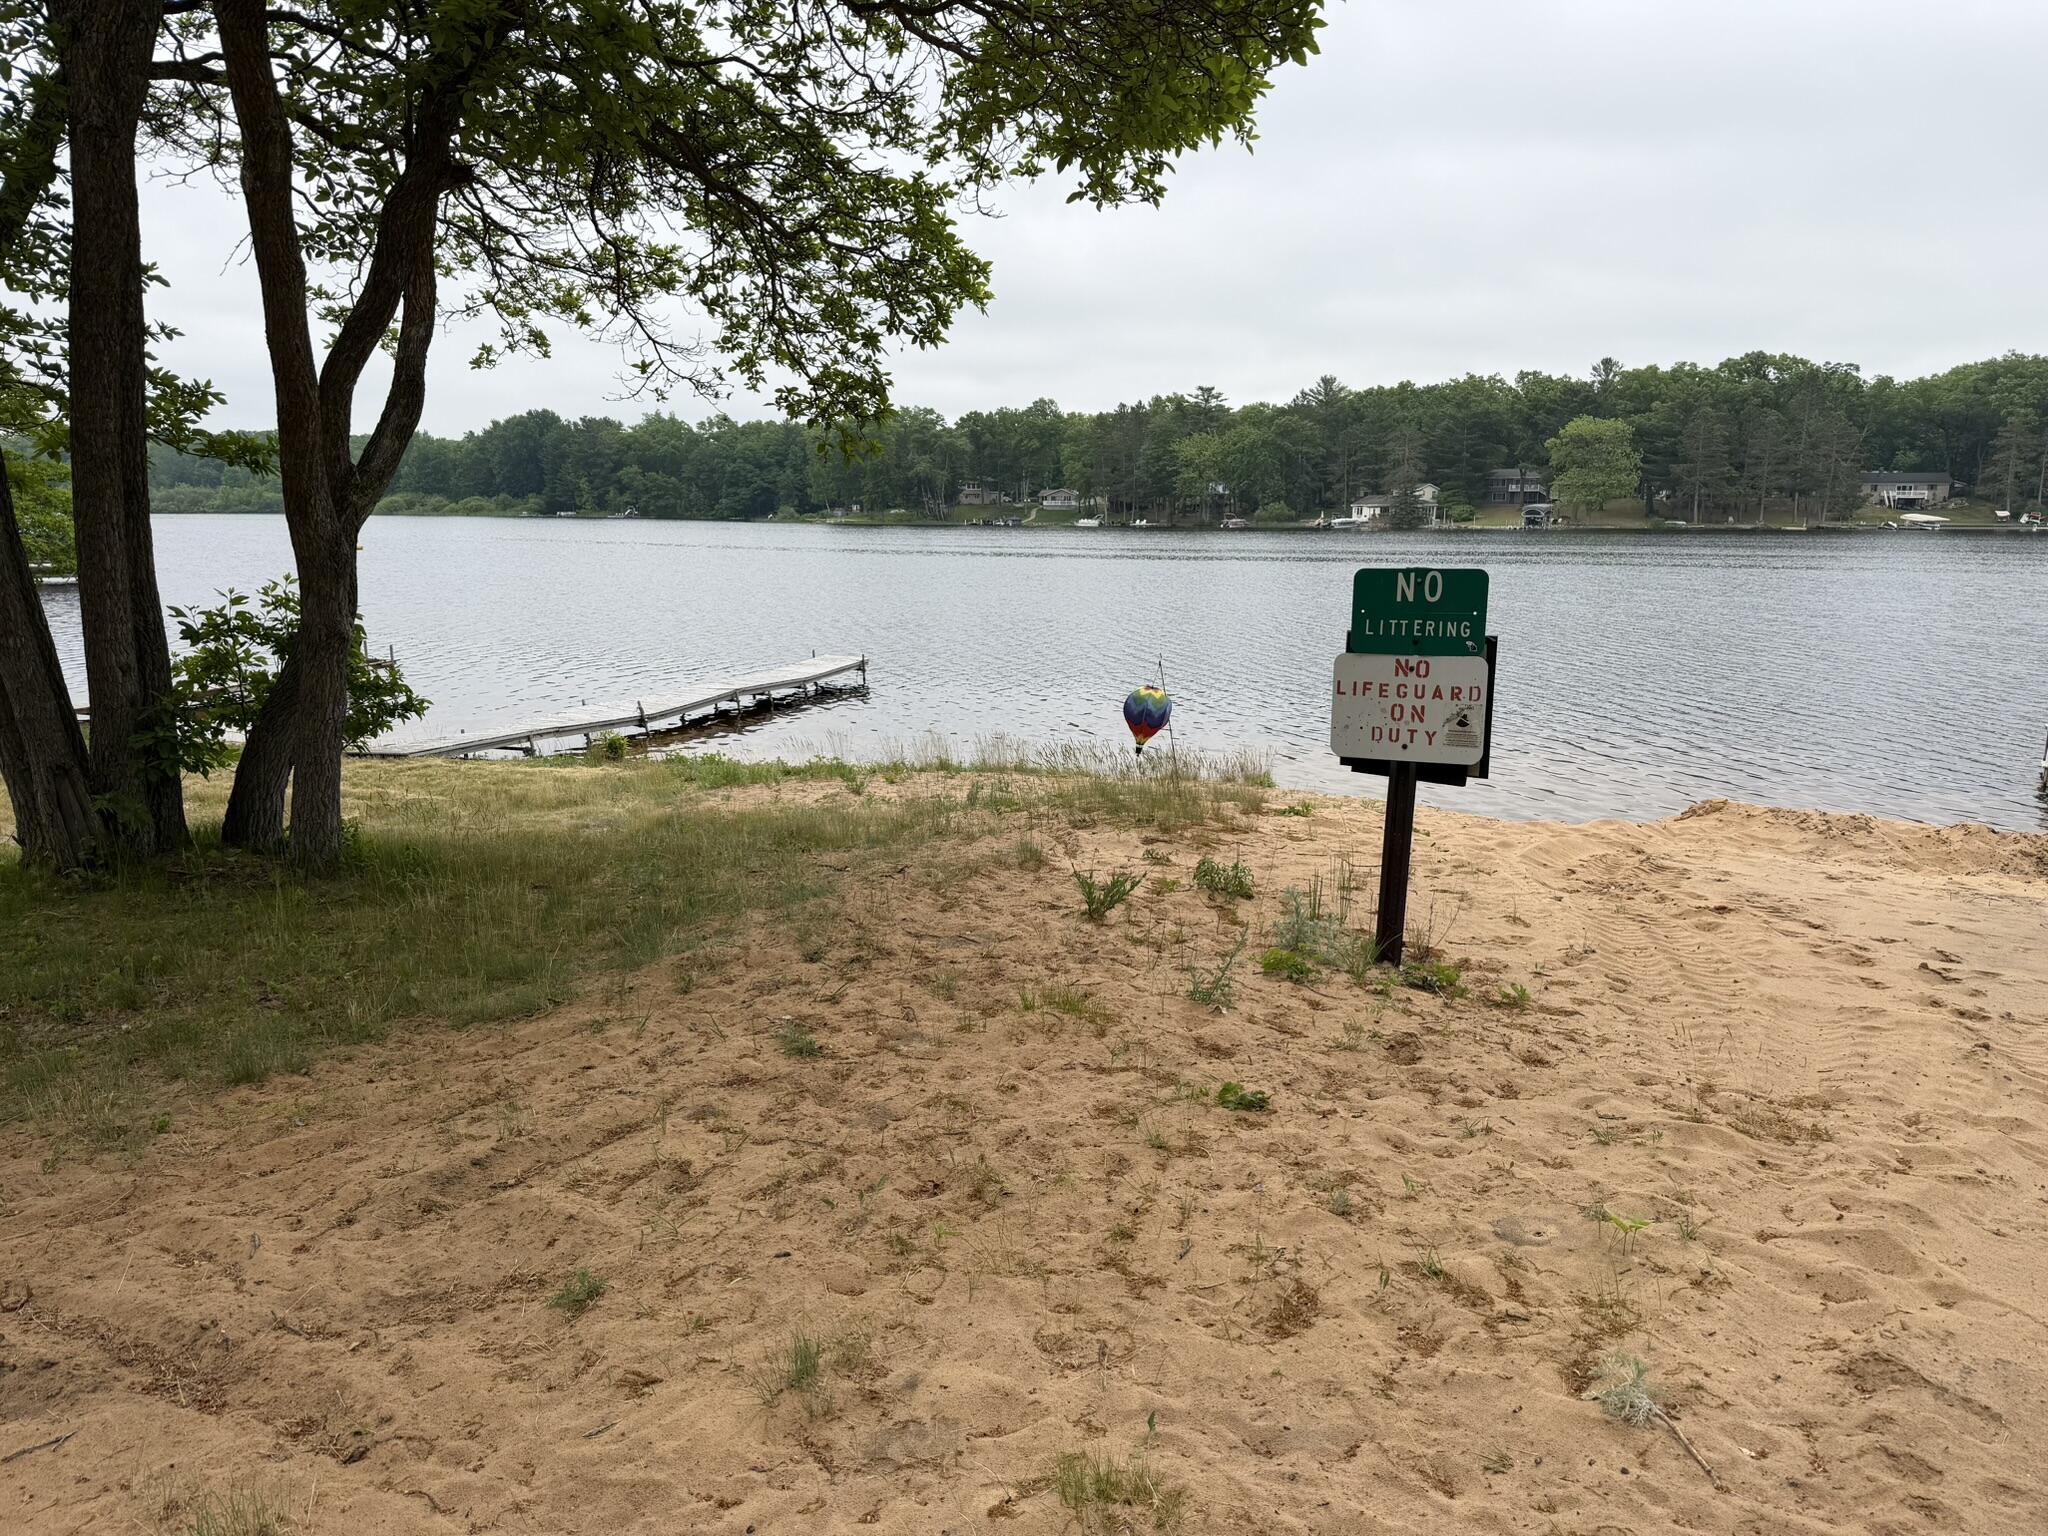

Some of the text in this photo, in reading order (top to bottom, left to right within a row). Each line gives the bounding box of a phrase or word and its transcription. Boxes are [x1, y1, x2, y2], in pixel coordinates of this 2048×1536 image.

[1396, 570, 1443, 602] NO
[1365, 619, 1472, 637] LITTERING
[1394, 658, 1430, 679] NO
[1336, 680, 1482, 702] LIFEGUARD
[1390, 703, 1425, 724] ON
[1371, 726, 1438, 746] DUTY
